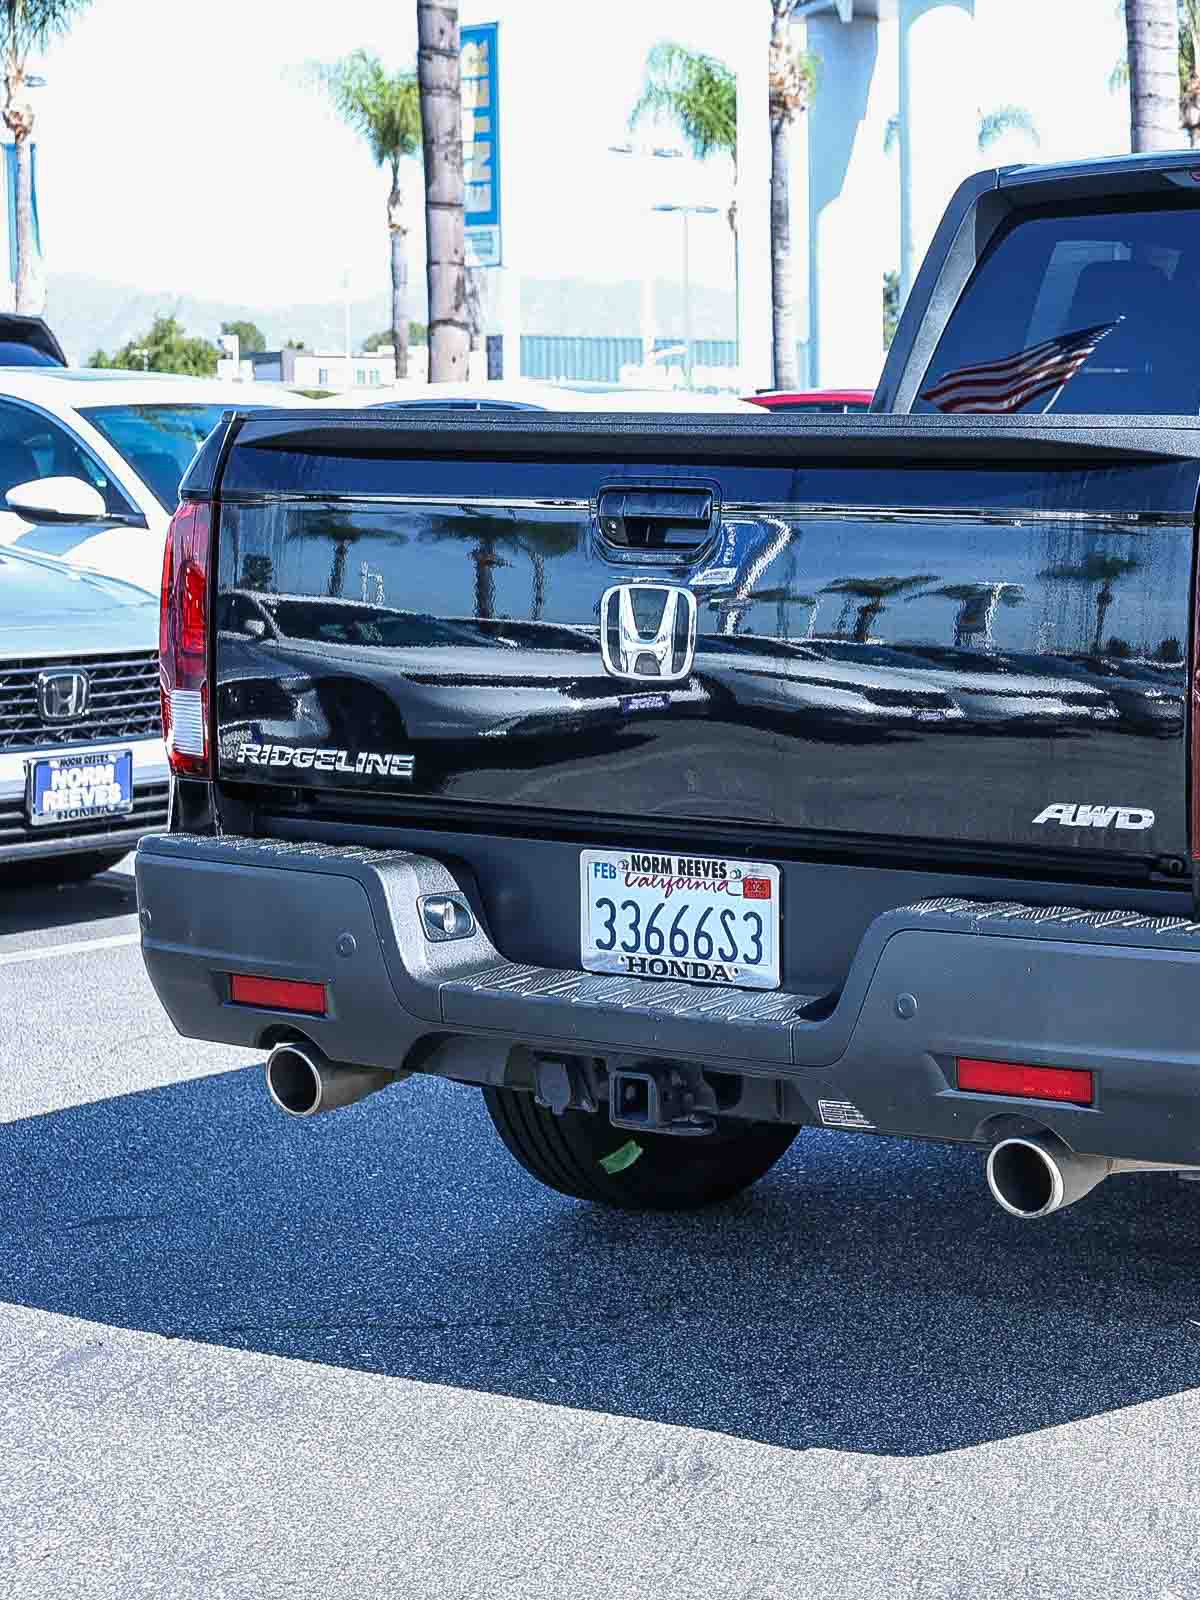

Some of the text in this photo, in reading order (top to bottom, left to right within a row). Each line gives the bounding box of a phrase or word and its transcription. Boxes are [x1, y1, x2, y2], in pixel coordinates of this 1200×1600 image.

[237, 743, 415, 777] RIDGELINE
[51, 764, 114, 792] NORM
[43, 783, 121, 813] REEVES
[1032, 802, 1155, 830] AWD
[593, 862, 617, 880] FEB
[631, 854, 728, 880] NORM REEVES
[595, 897, 763, 965] 33666S3
[626, 956, 733, 982] HONDA
